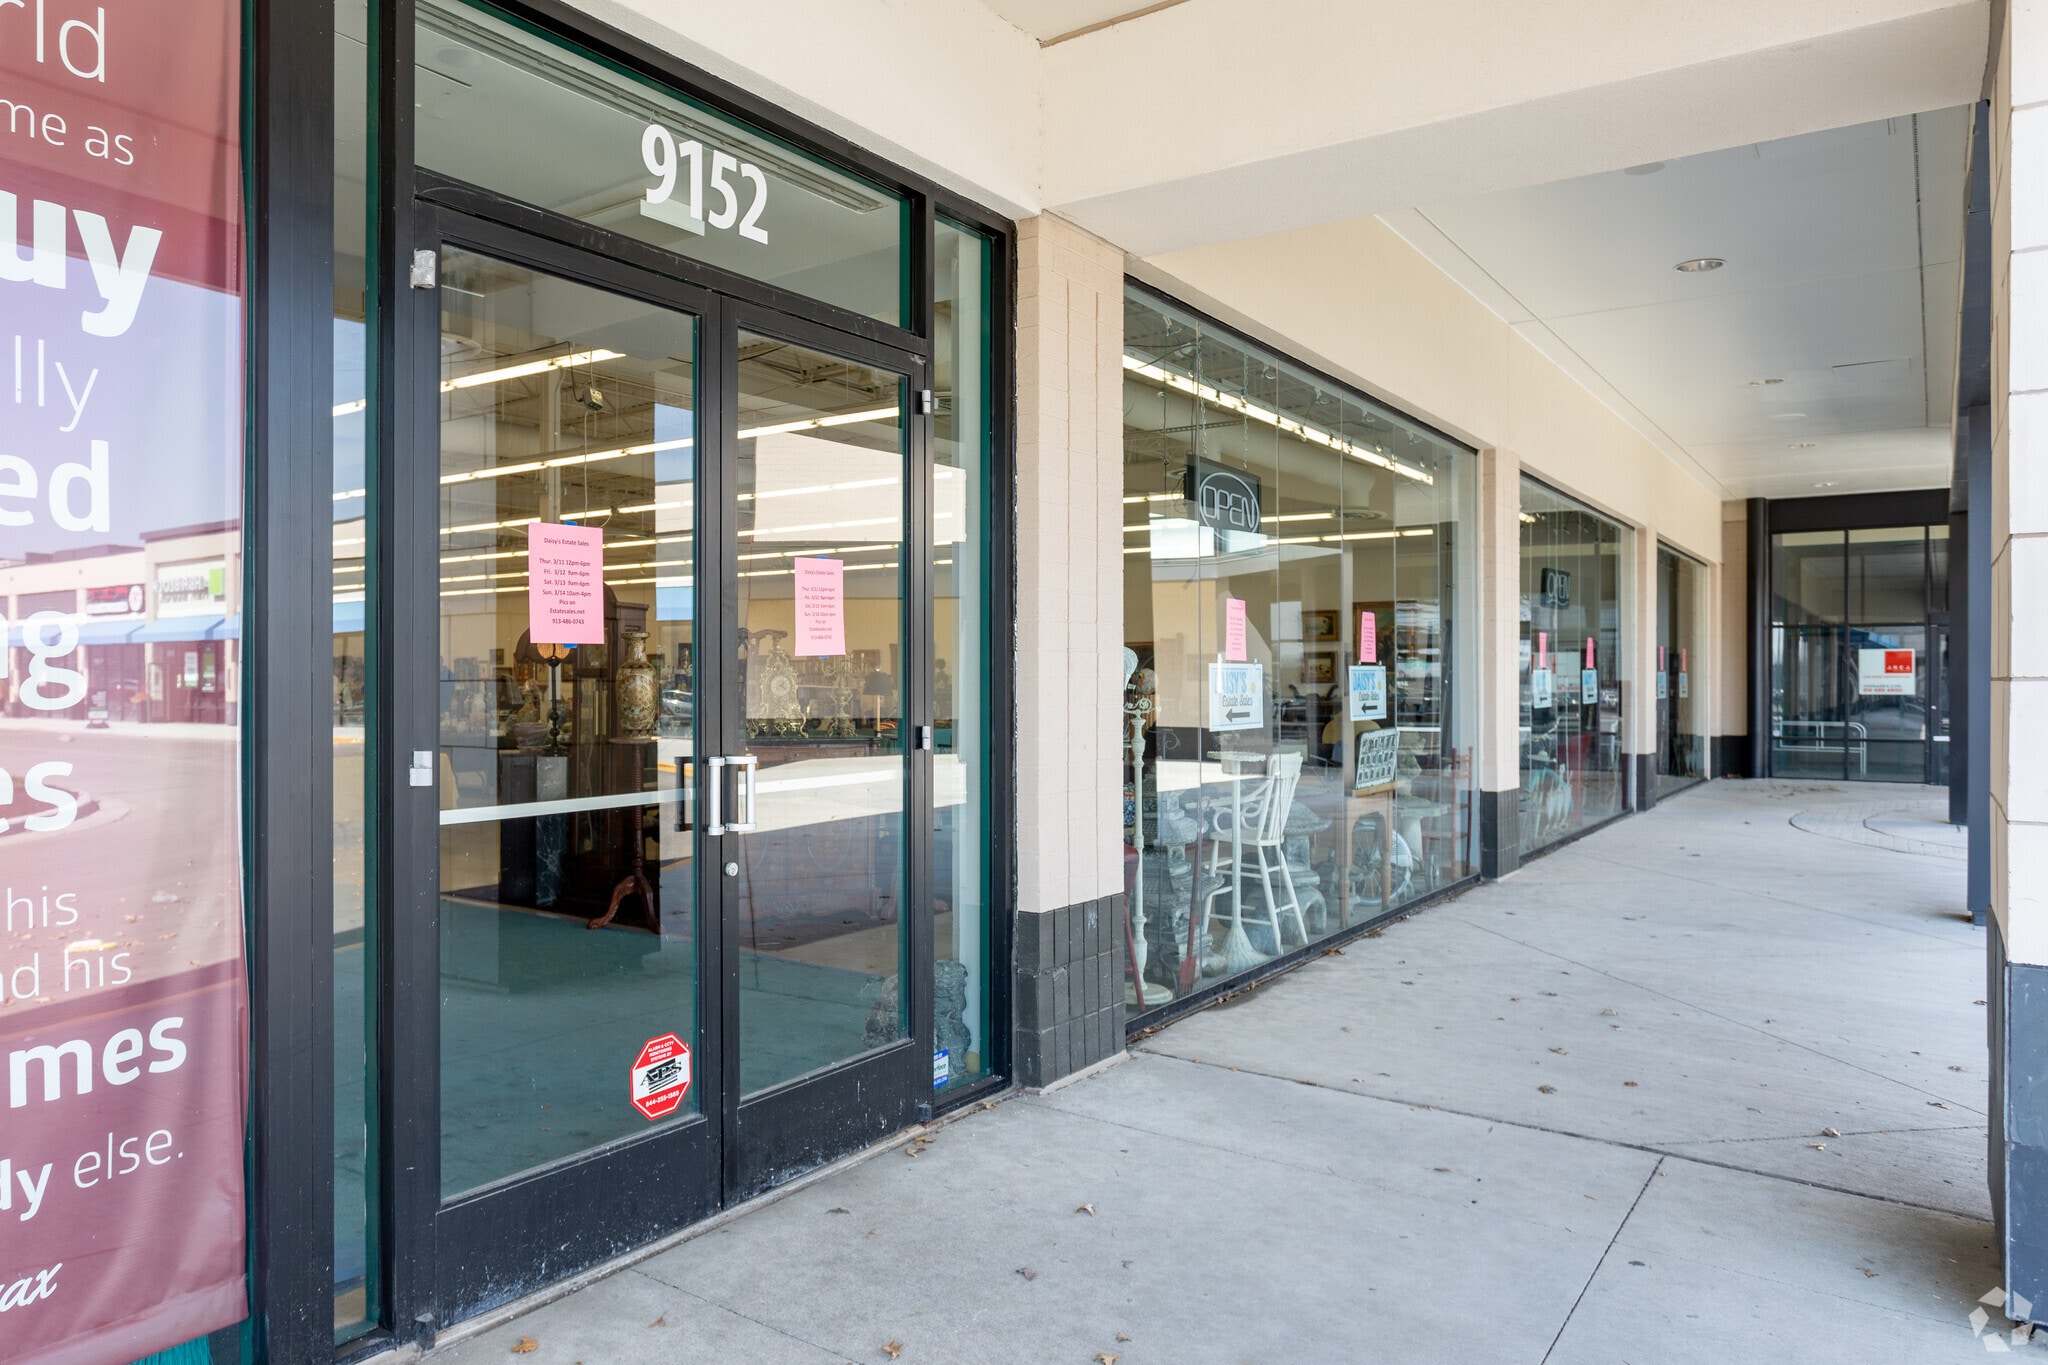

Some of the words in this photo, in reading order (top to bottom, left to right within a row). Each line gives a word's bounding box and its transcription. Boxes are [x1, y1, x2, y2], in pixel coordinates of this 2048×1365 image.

[85, 125, 134, 166] as
[641, 124, 768, 245] 9152
[0, 189, 163, 338] uy
[1203, 485, 1256, 529] OPEN
[0, 611, 88, 711] g
[0, 761, 78, 832] s
[0, 952, 40, 1004] d
[64, 946, 132, 993] his
[9, 1016, 187, 1109] mes
[73, 1129, 184, 1189] else.
[0, 1262, 63, 1312] ax
